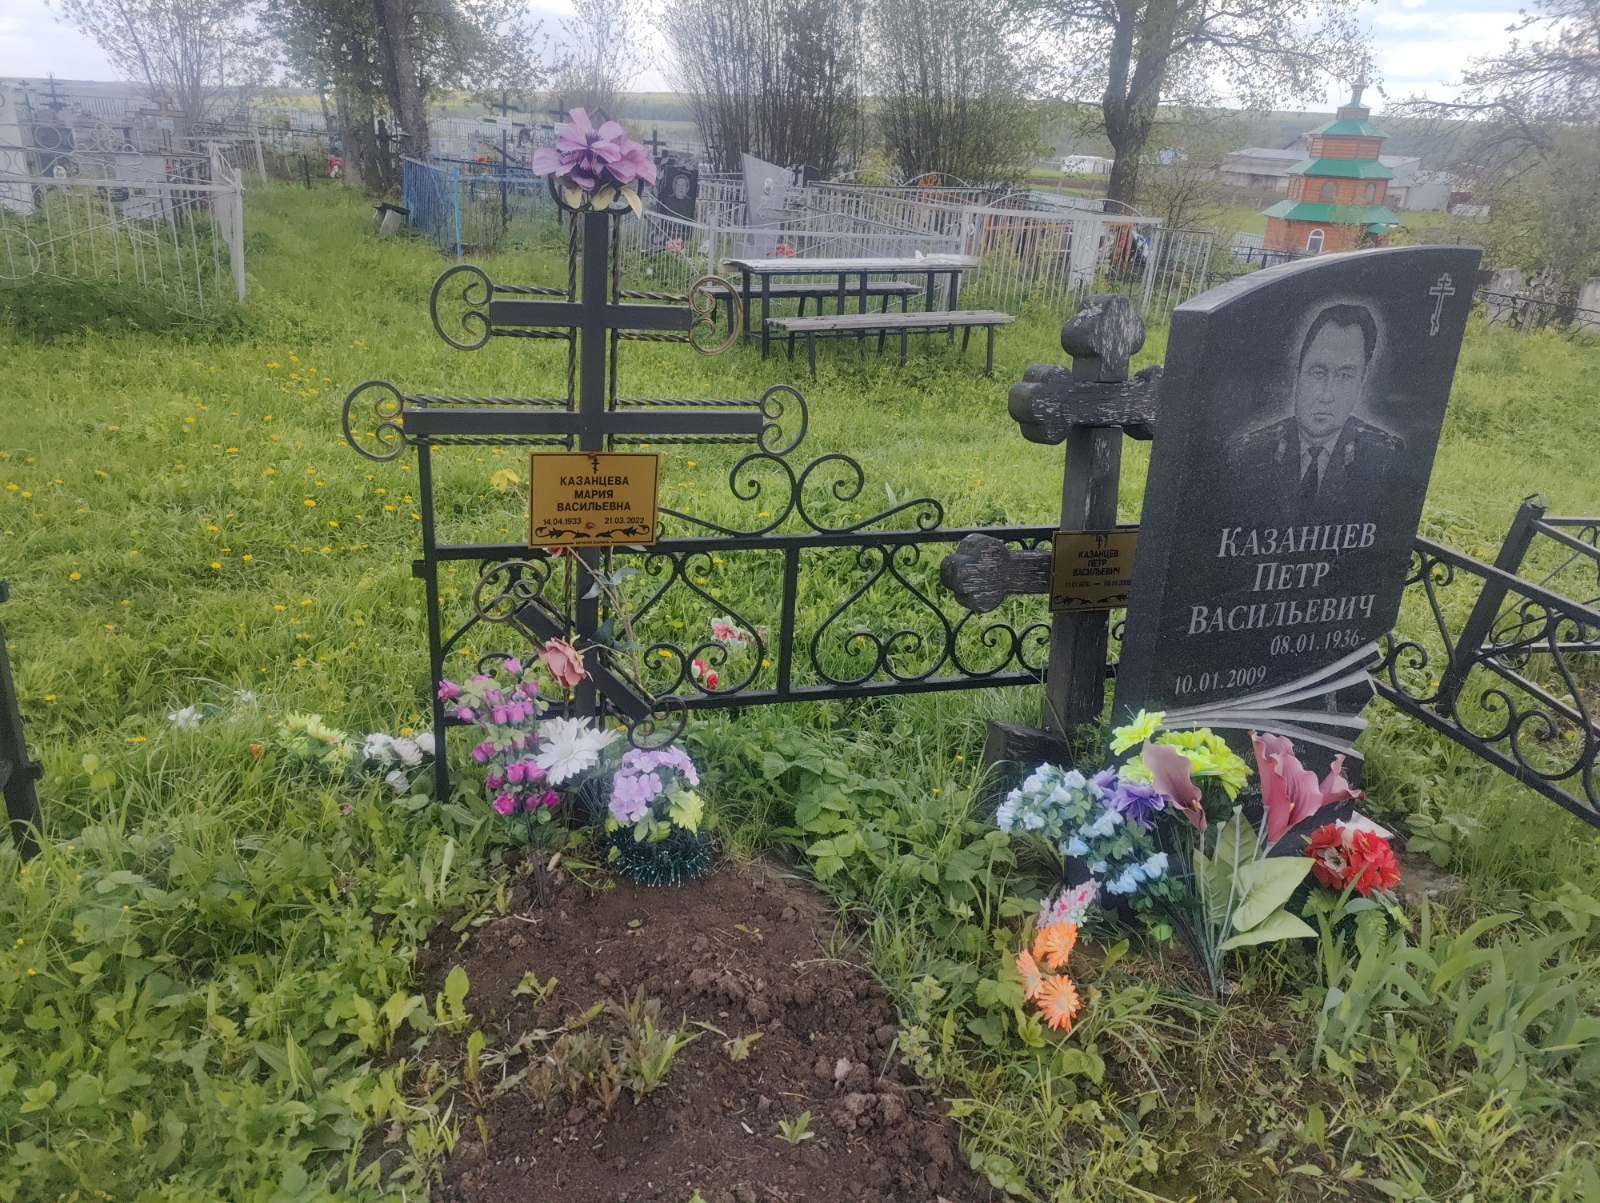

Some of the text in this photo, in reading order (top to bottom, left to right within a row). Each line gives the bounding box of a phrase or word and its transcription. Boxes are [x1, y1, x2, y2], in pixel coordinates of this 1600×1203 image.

[560, 476, 630, 488] КАЗАНЦЕВА
[574, 489, 614, 499] МАРИЯ
[557, 501, 631, 512] ВАСИЛЬЕВНА
[543, 517, 645, 526] 14.04.1933 21.03.2022
[1216, 522, 1377, 558] КАЗАНЦЕВ
[1078, 549, 1119, 559] КАЗАНЦЕВ
[1087, 559, 1107, 567] ПЕТР
[1072, 566, 1121, 576] ВАСИЛЬЕВИЧ
[1252, 561, 1330, 592] ПЕТР
[1187, 594, 1377, 635] ВАСИЛЬЕВИЧ
[1174, 665, 1267, 695] 10.01.2009
